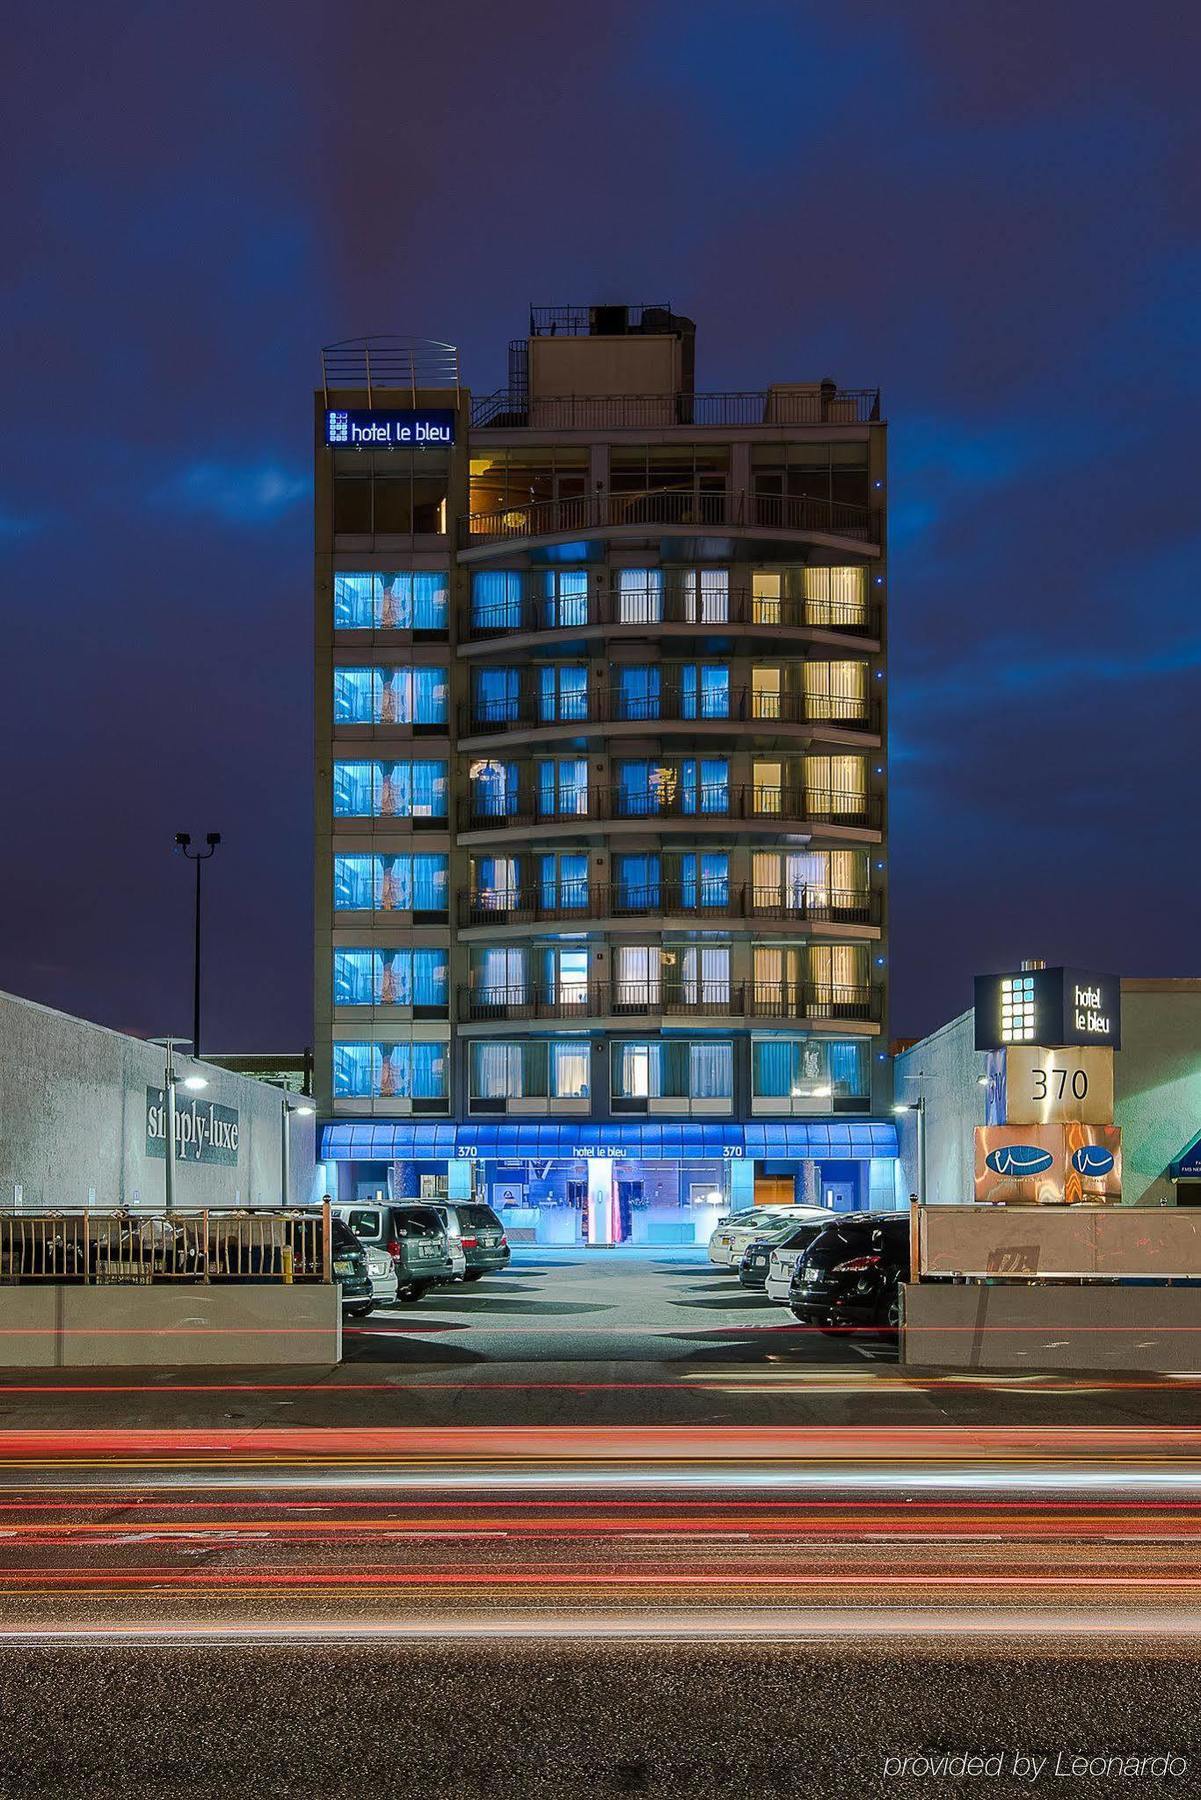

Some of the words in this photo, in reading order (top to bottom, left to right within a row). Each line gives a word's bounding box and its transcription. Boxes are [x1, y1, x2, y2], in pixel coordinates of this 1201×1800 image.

[351, 422, 391, 441] hotel
[396, 422, 411, 441] le
[415, 422, 450, 441] bleu
[1074, 985, 1101, 1009] hotel
[1075, 1009, 1086, 1031] le
[1087, 1011, 1110, 1034] bleu
[1031, 1069, 1088, 1101] 370
[458, 1146, 478, 1157] 370
[572, 1146, 595, 1157] hotel
[597, 1146, 606, 1157] le
[607, 1146, 627, 1157] bleu
[722, 1146, 743, 1157] 370
